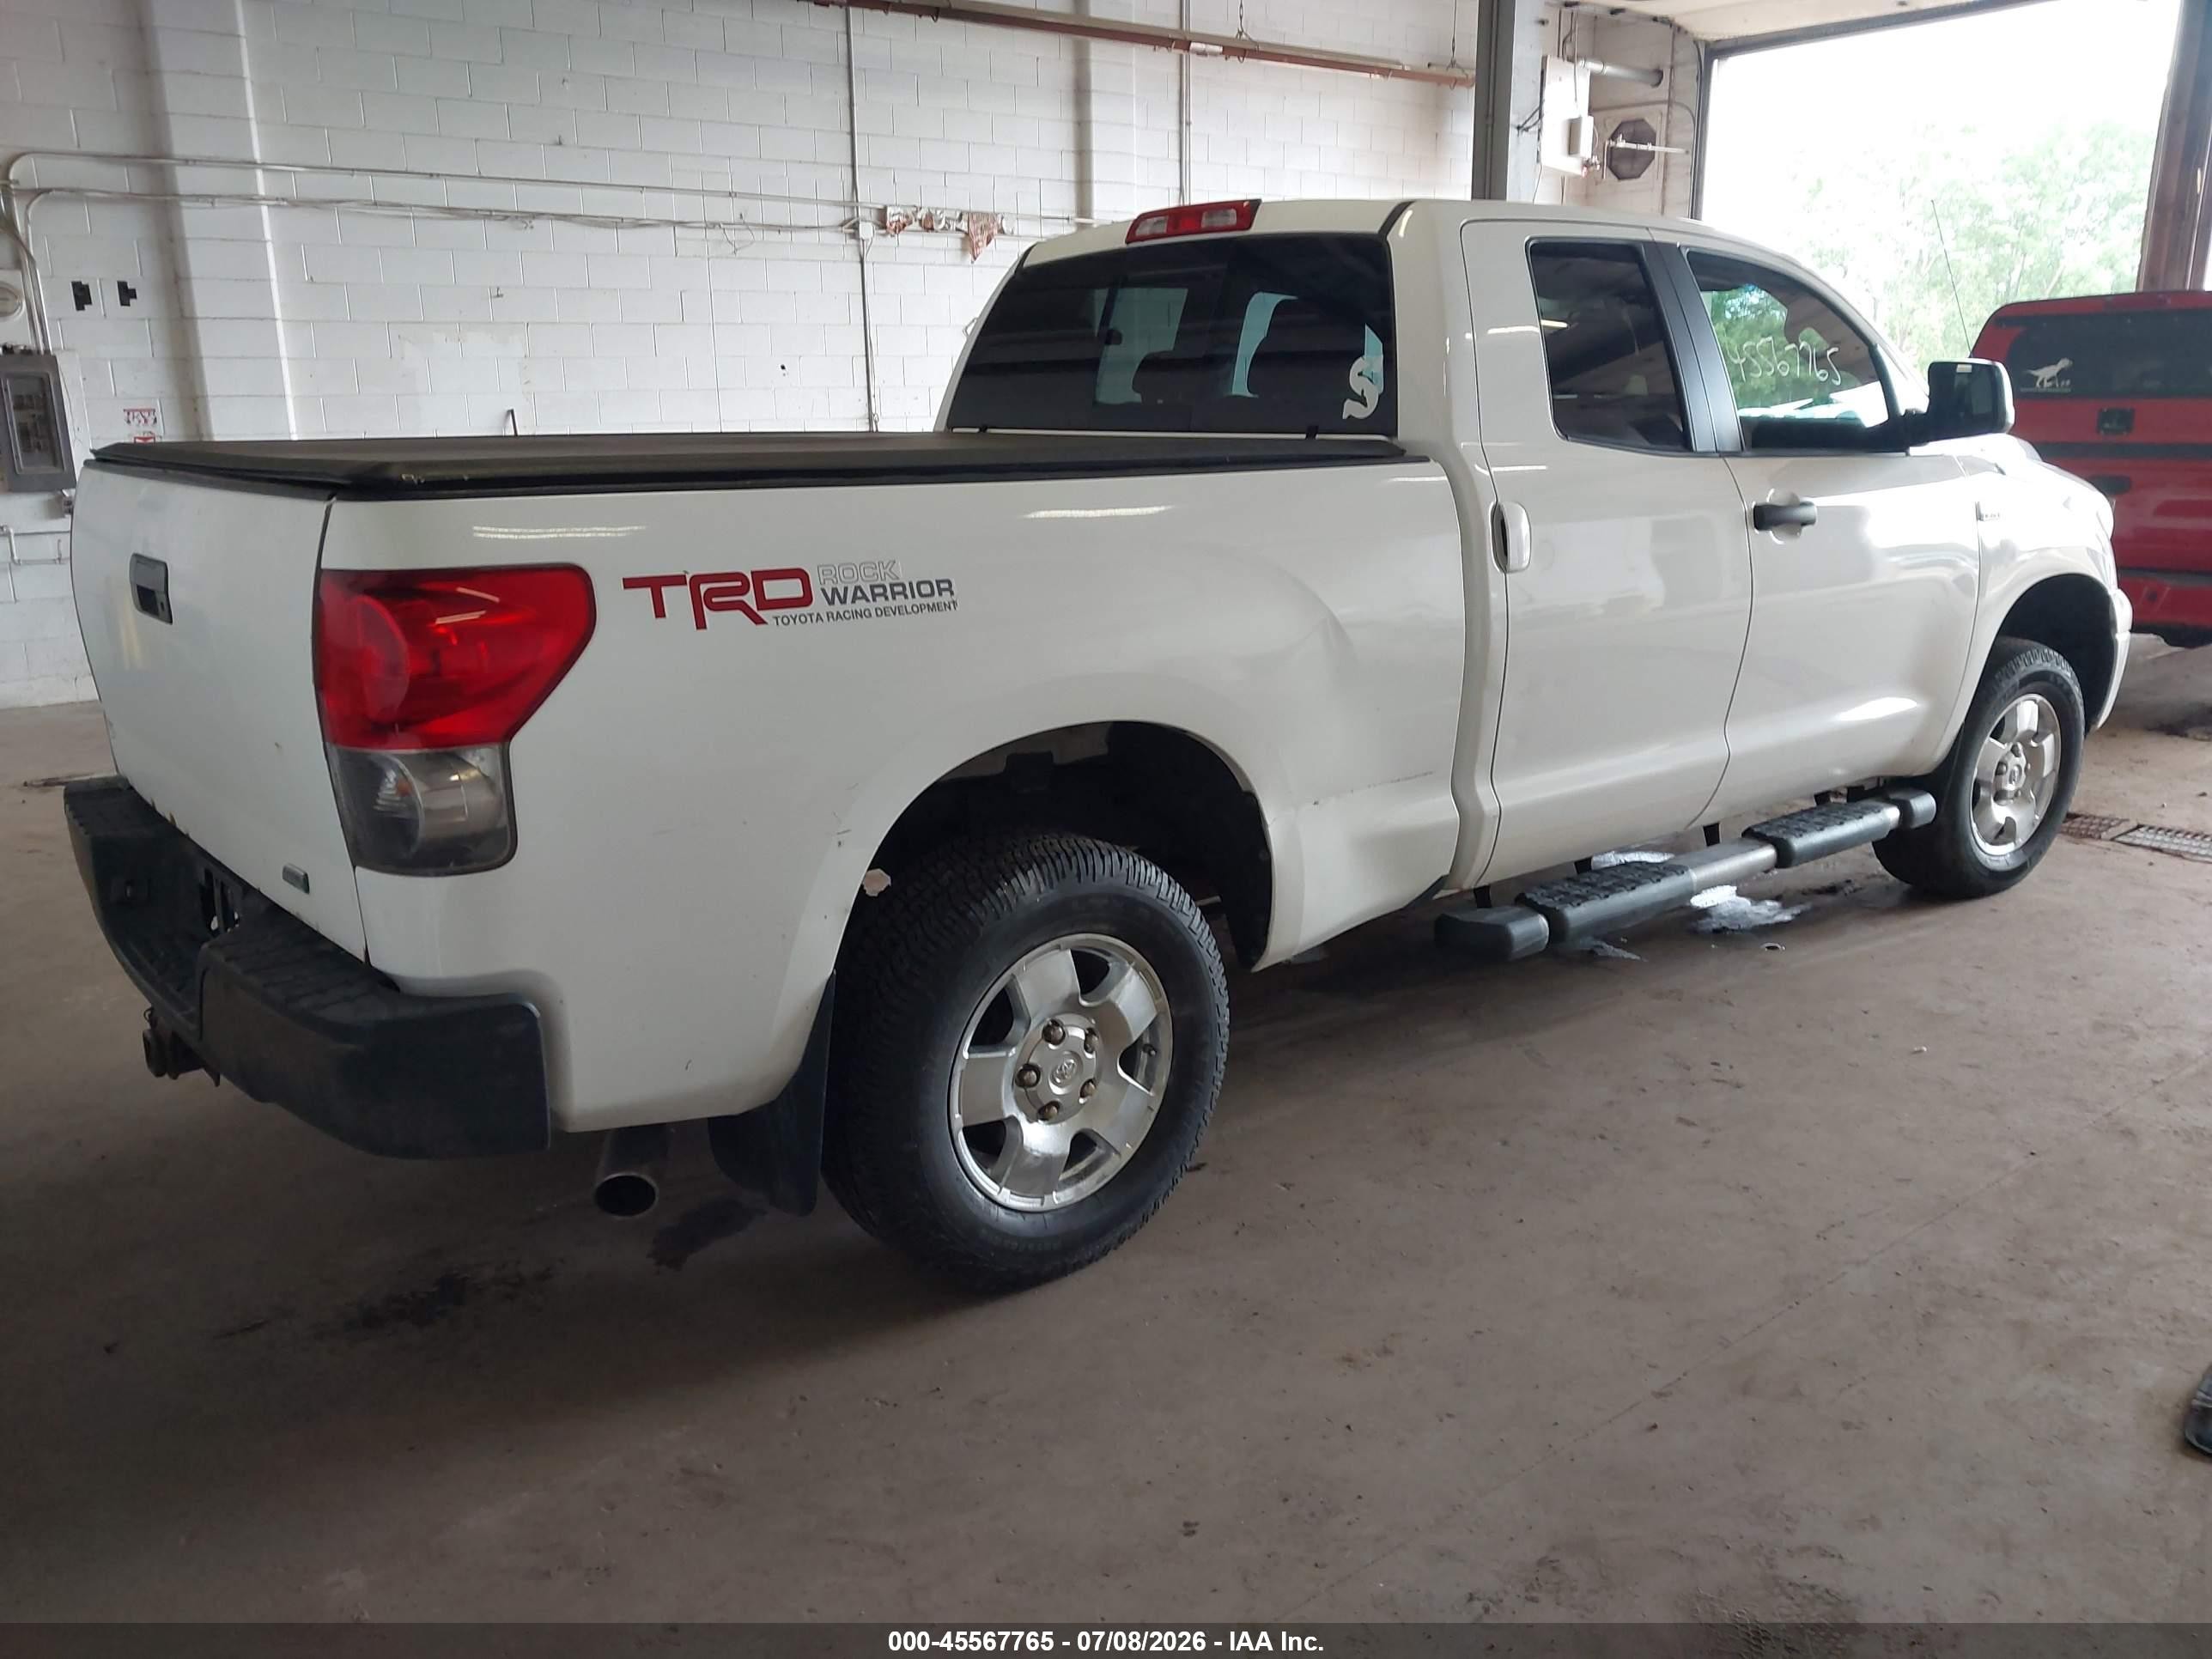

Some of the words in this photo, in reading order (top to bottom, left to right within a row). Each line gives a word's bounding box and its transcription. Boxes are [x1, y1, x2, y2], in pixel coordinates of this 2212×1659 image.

[1727, 336, 1842, 386] 45567765
[817, 560, 900, 586] ROCK
[622, 567, 814, 631] TRD
[820, 578, 955, 606] WARRIOR
[773, 611, 824, 627] TOYOTA
[826, 606, 872, 623] RACING
[875, 599, 959, 618] DEVELOPMENT
